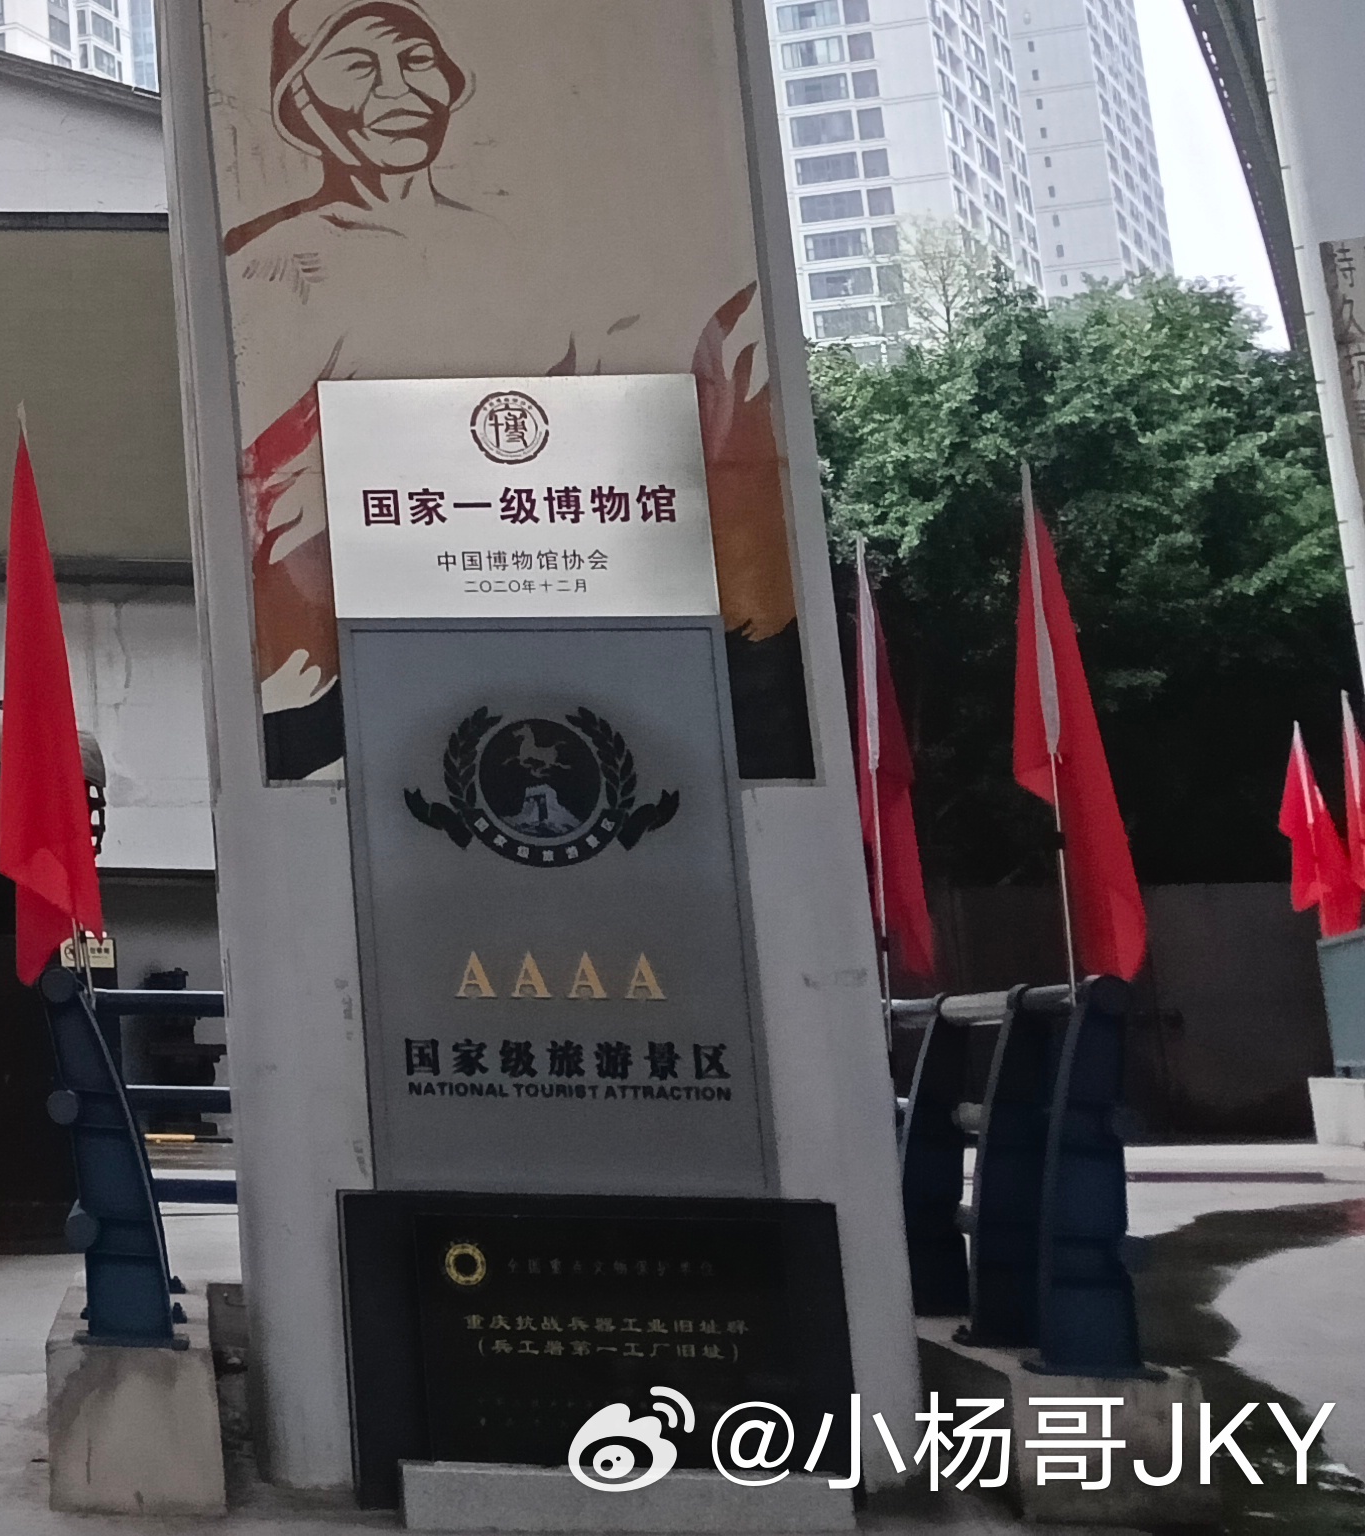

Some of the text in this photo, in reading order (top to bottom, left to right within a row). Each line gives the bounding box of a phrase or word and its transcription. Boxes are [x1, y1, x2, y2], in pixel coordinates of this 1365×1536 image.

[362, 484, 677, 526] 国家一级博物馆
[437, 549, 608, 572] 中国博物馆协会
[405, 1038, 732, 1081] 国家级旅游景区
[408, 1081, 732, 1102] NATIONAL TOURIST ATTRACTION
[464, 1313, 749, 1335] 重庆抗战兵器工业旧址群
